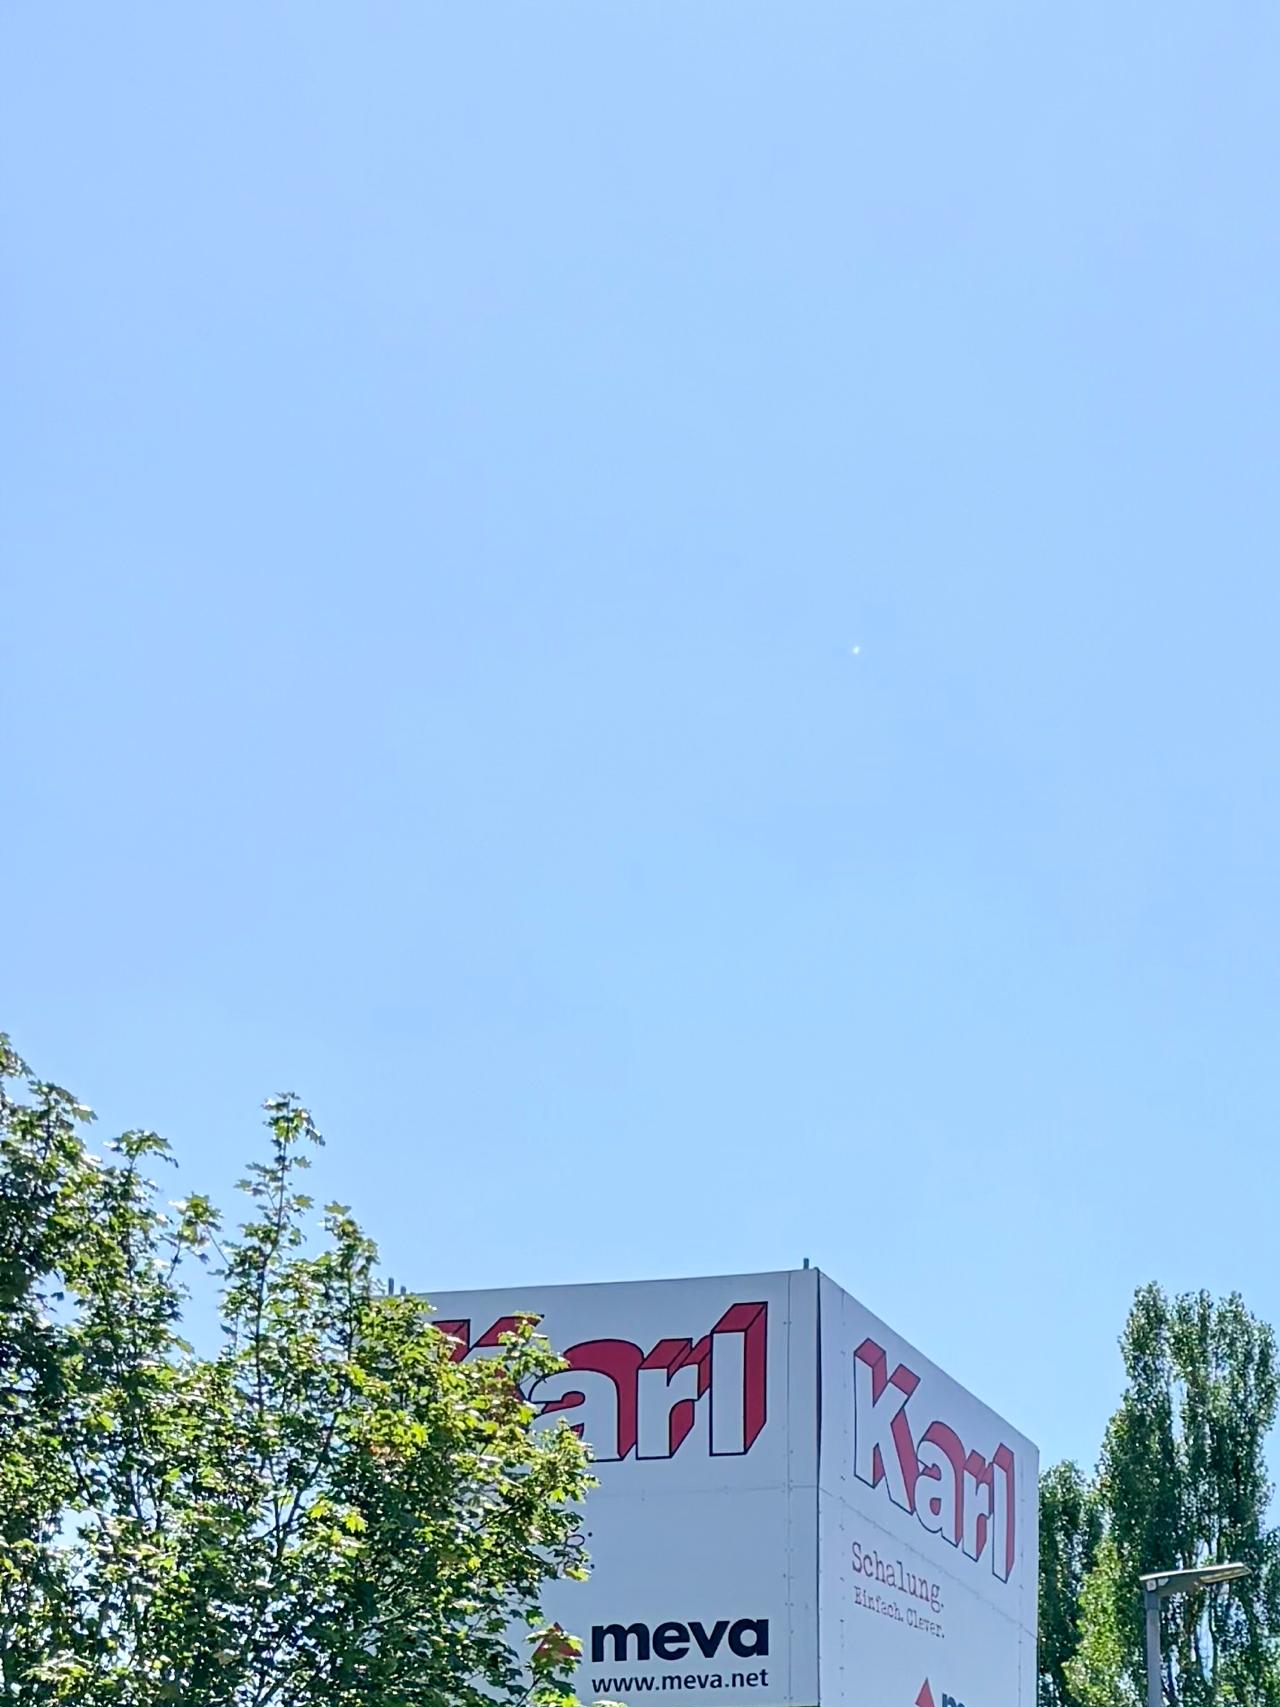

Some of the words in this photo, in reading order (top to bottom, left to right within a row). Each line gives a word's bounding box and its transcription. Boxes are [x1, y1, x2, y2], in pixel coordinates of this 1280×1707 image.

[853, 1337, 1016, 1584] Karl
[852, 1541, 945, 1614] Schalung.
[591, 1618, 770, 1663] meva
[591, 1669, 769, 1693] www.meva.net
